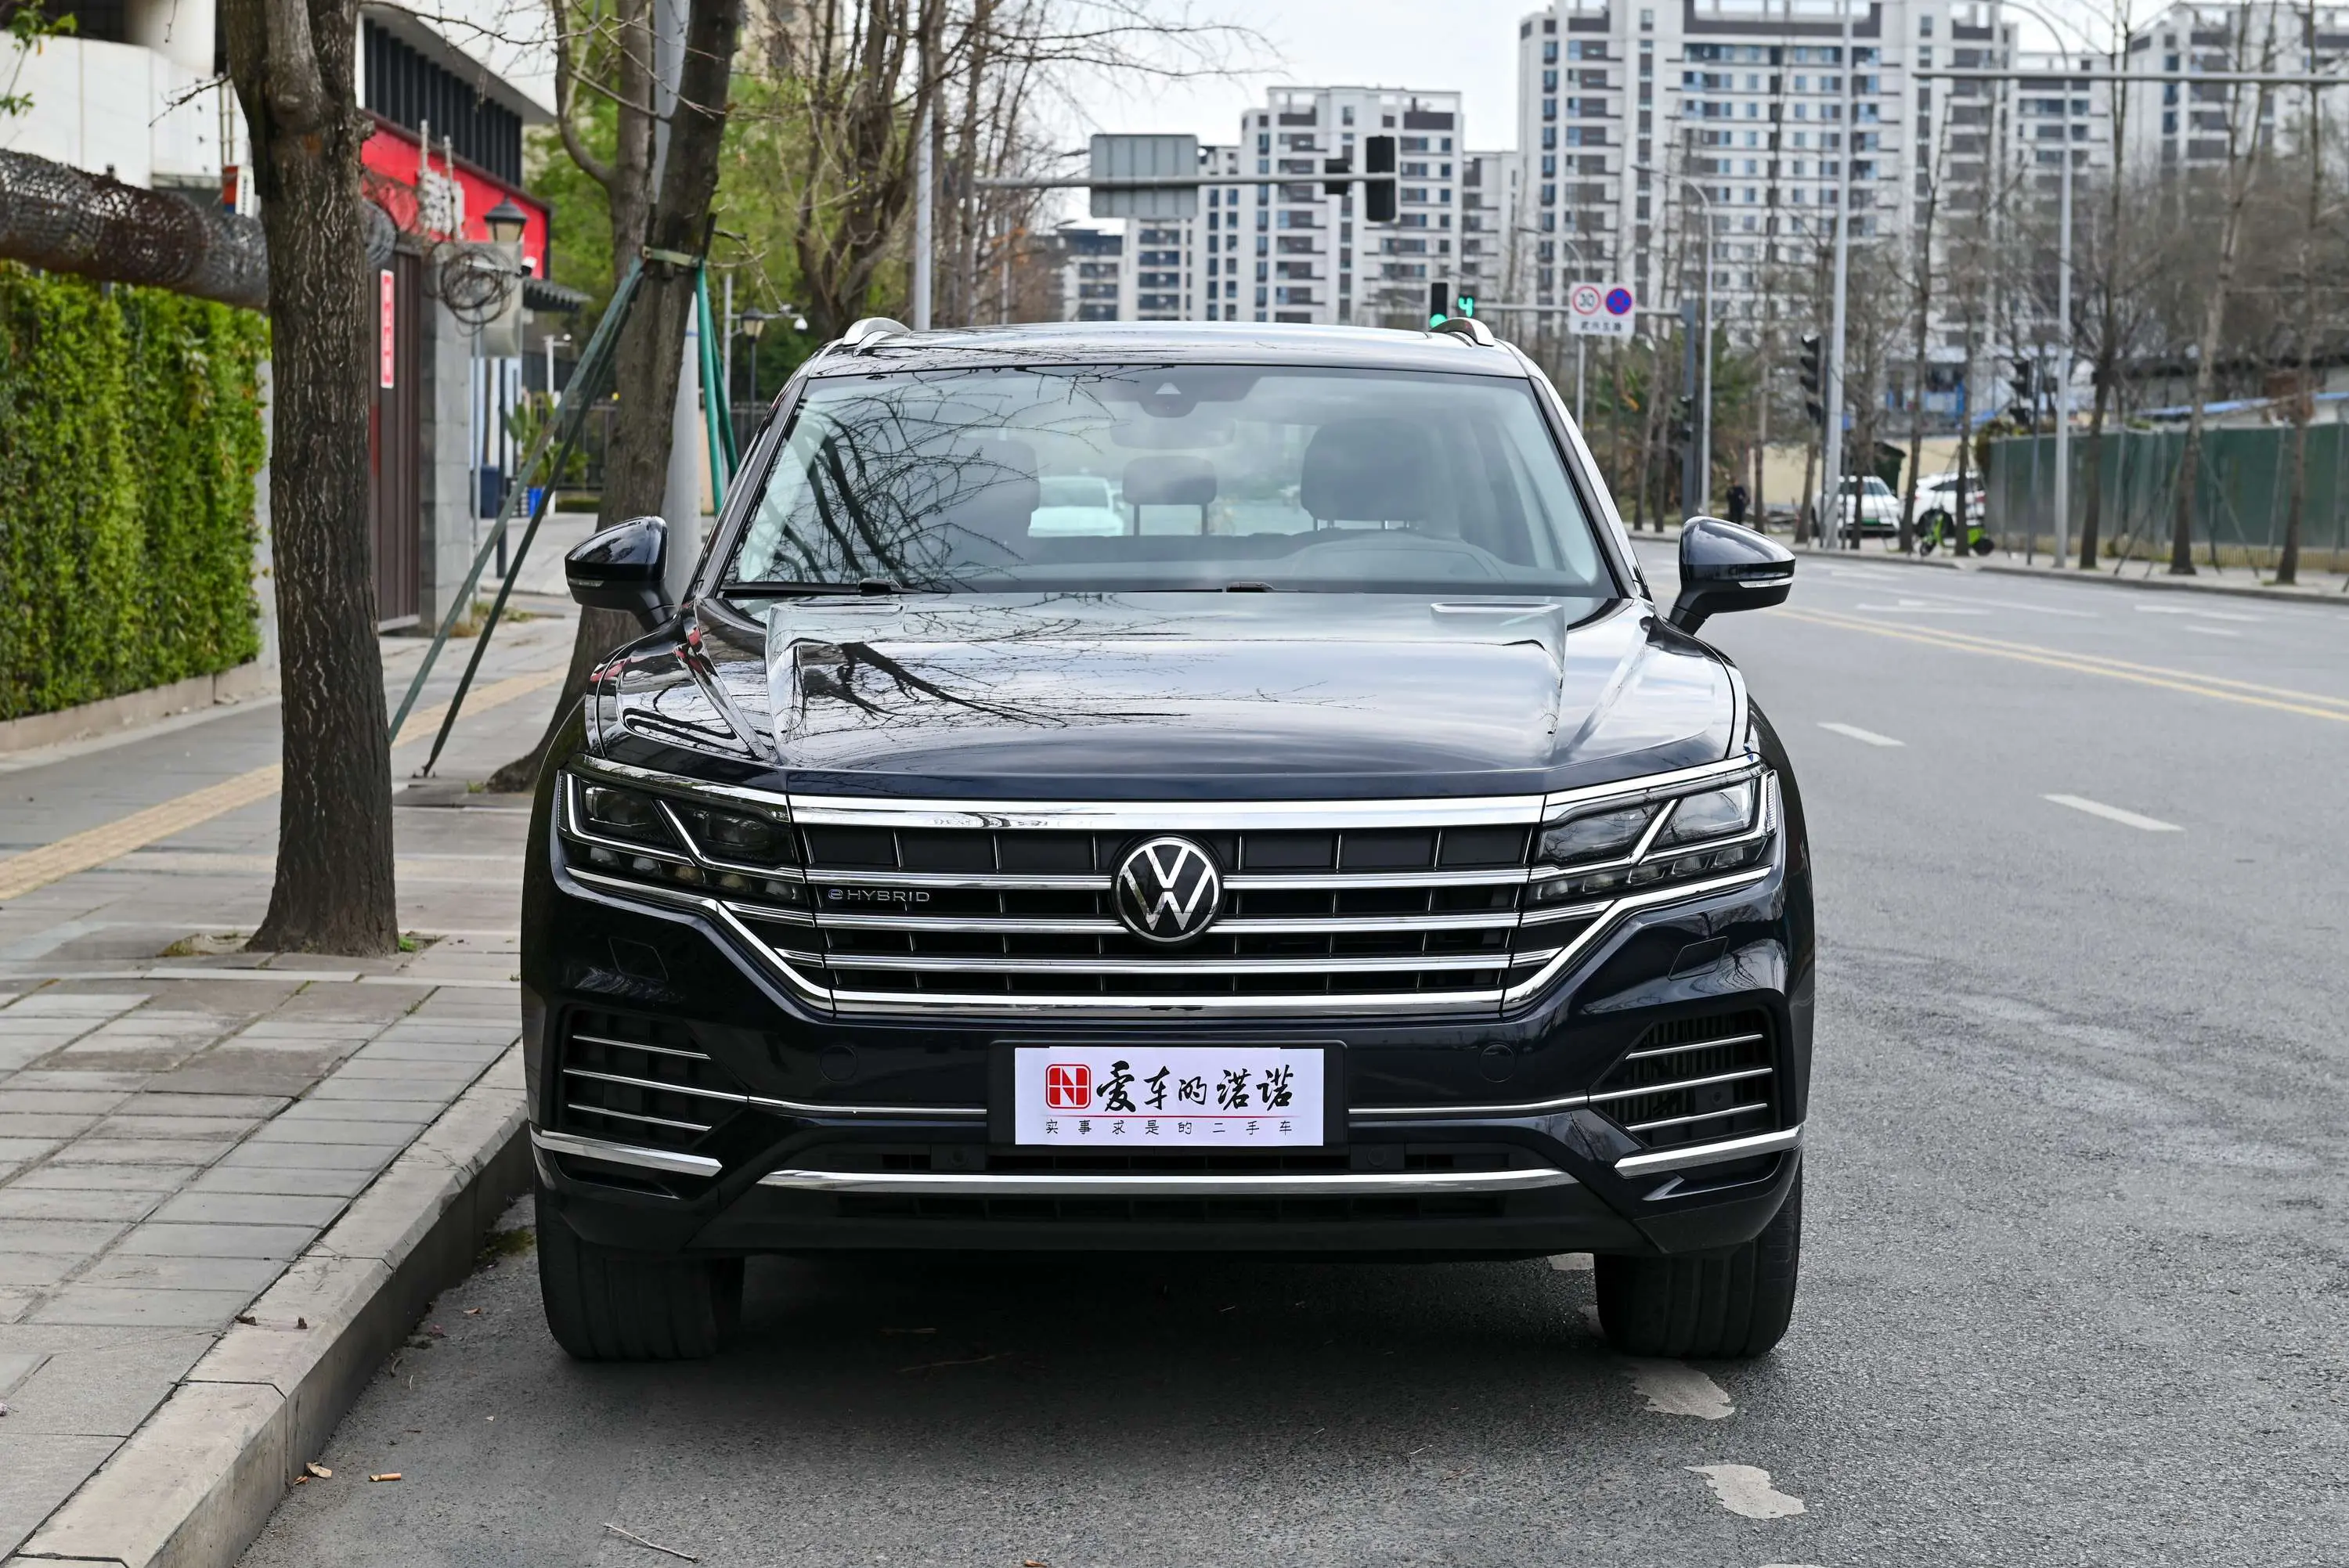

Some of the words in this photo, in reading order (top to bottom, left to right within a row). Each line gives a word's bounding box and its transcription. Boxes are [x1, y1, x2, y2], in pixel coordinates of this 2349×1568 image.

[1458, 297, 1473, 318] 4
[1579, 293, 1594, 307] 30
[1045, 1119, 1293, 1136] 实事求是的二手车
